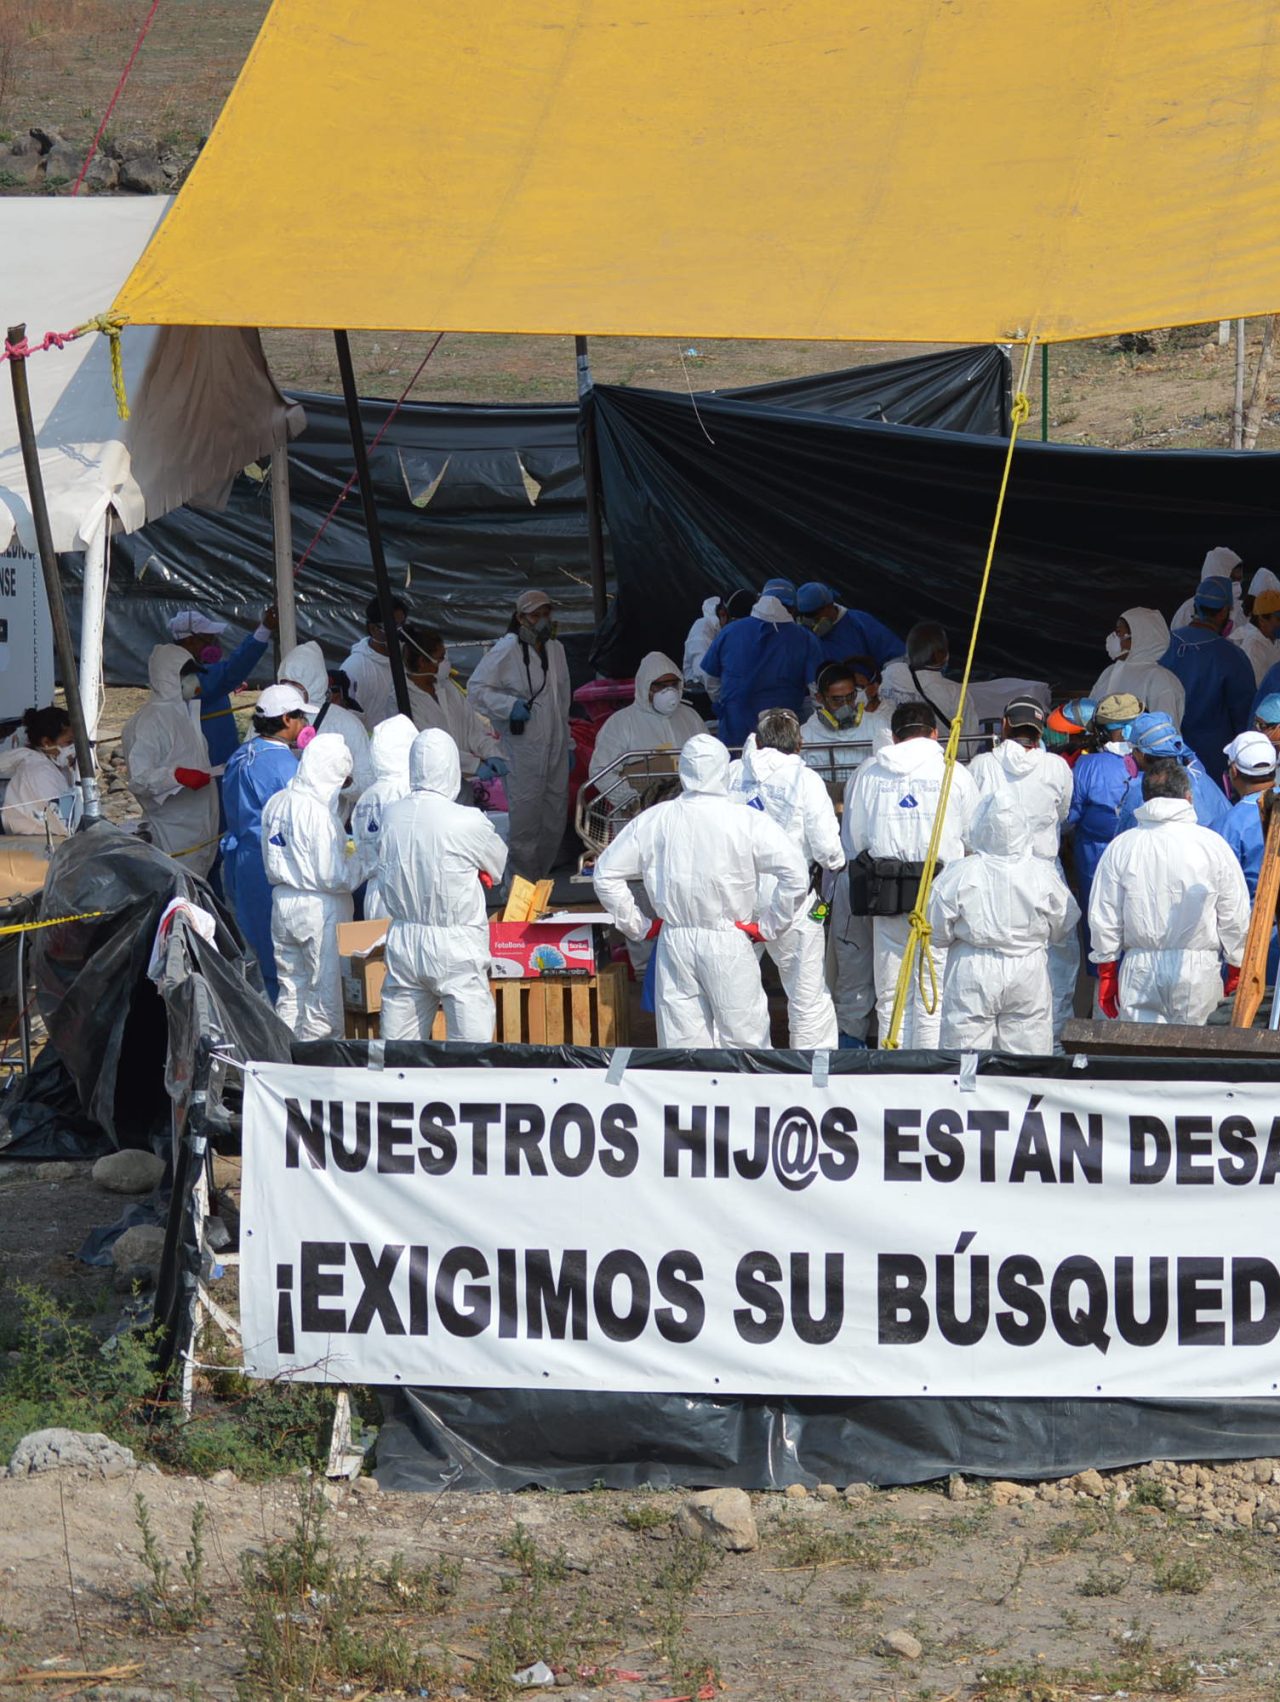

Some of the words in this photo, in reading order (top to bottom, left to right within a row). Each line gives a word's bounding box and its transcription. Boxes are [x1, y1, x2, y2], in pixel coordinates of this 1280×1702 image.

[285, 1098, 640, 1178] NUESTROS
[663, 1105, 860, 1191] HIJ@S
[883, 1094, 1104, 1184] ESTÁN
[276, 1241, 706, 1355] ¡EXIGIMOS
[733, 1250, 845, 1346] SU
